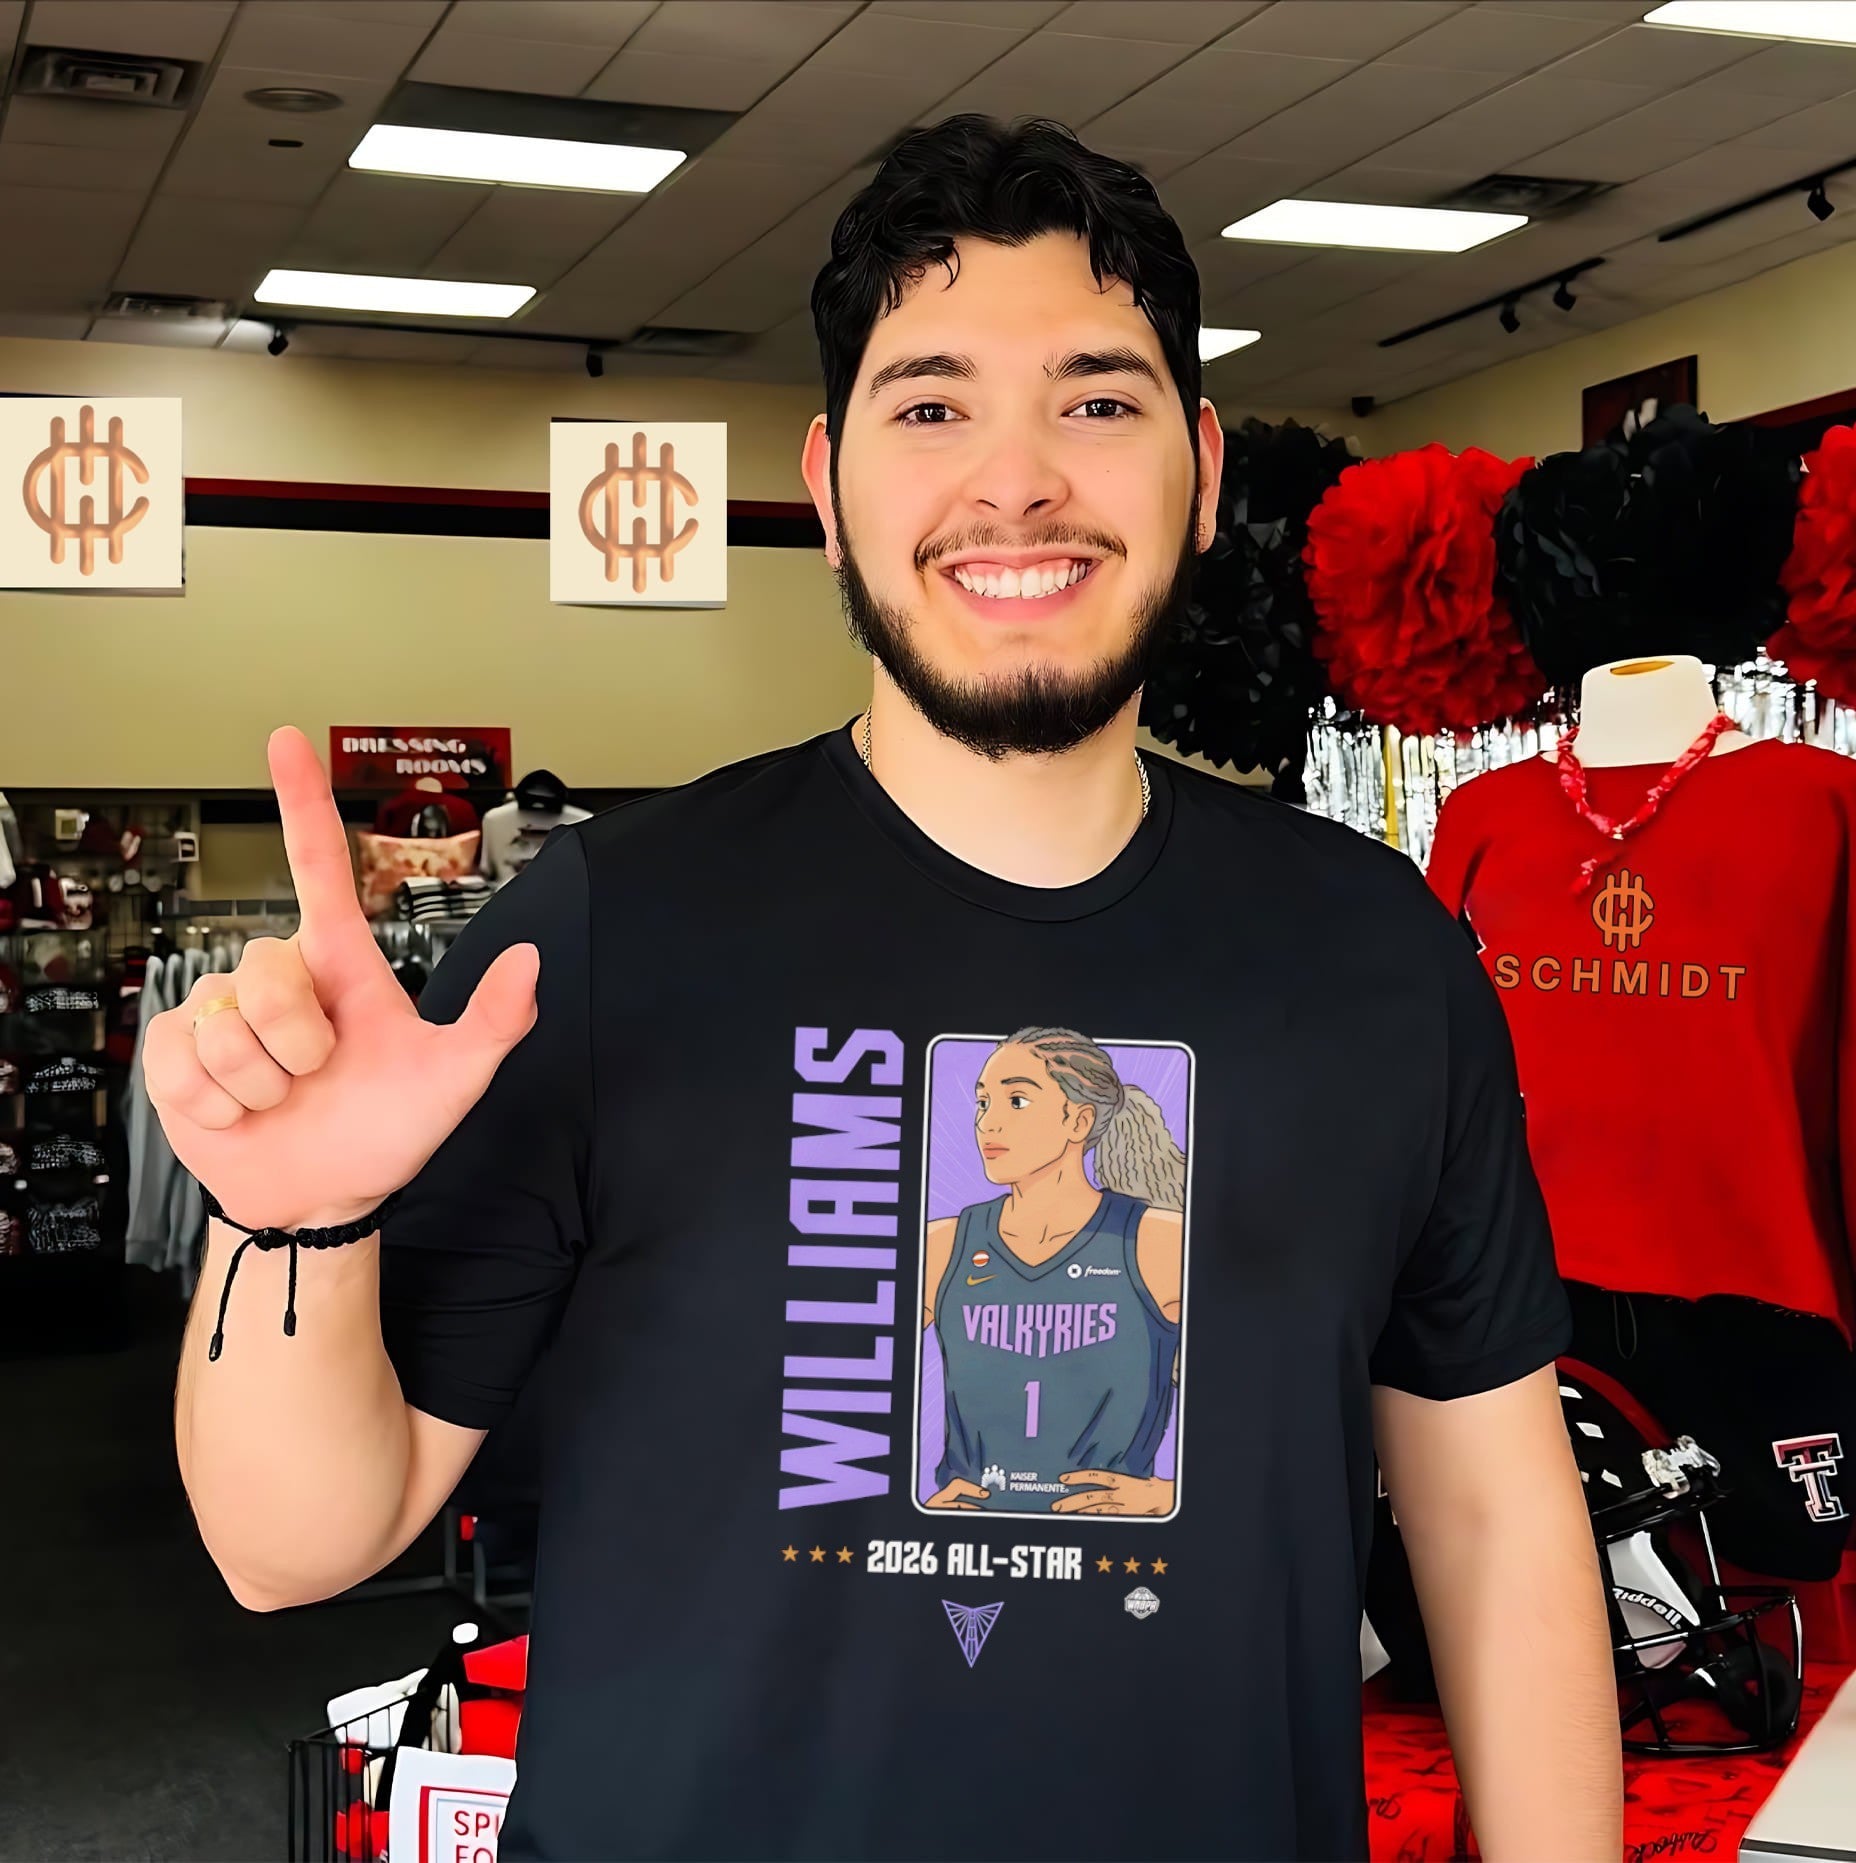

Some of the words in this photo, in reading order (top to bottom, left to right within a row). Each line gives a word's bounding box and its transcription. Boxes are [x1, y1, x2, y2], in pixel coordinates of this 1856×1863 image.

[342, 737, 466, 753] DRESSING
[396, 758, 486, 774] ROOMS
[1495, 953, 1746, 1000] SCHMIDT
[778, 1026, 905, 1511] WILLIAMS
[962, 1303, 1117, 1358] VALKYRIES
[1024, 1381, 1041, 1438] 1
[1010, 1472, 1038, 1482] KAISER
[867, 1540, 938, 1575] 2026
[947, 1543, 1082, 1580] ALL-STAR
